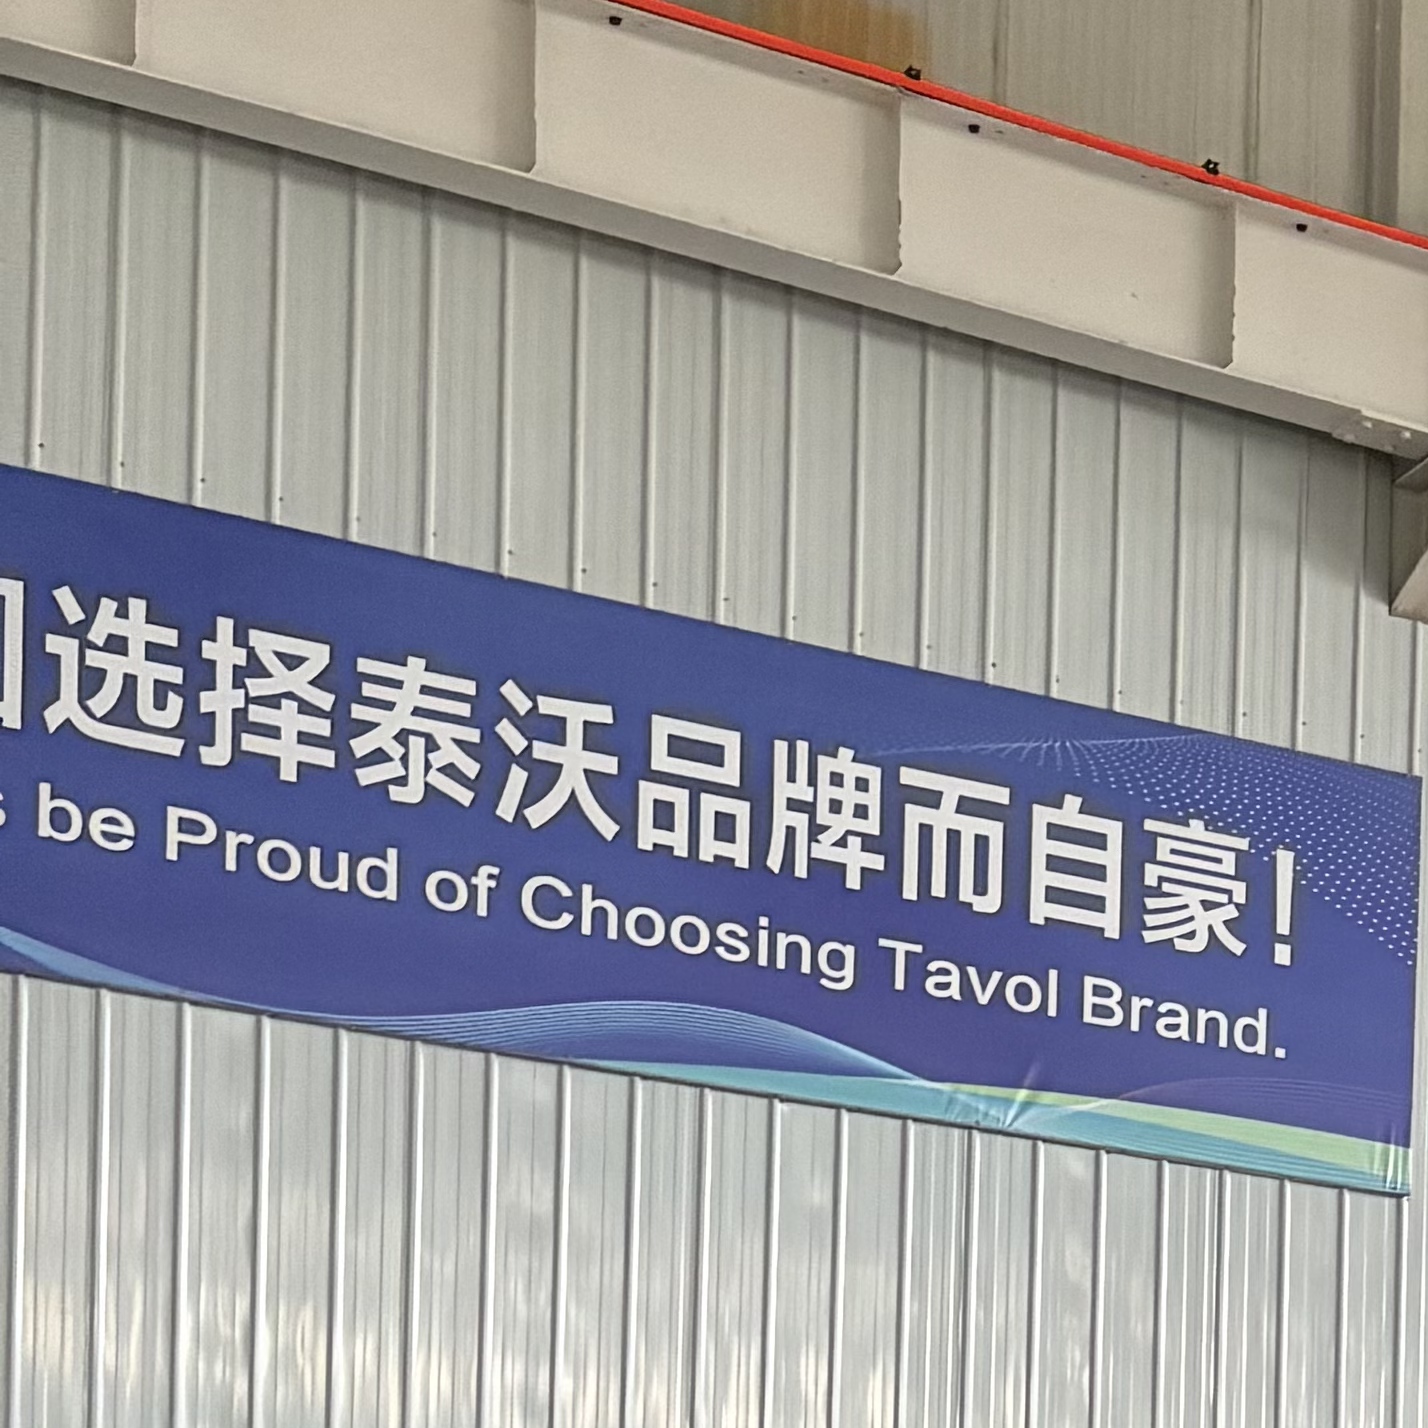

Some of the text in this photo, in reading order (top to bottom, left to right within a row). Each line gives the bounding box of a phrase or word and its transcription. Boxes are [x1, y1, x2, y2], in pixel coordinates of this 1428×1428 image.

[0, 577, 1295, 966] 选择泰沃品牌而自豪！
[38, 782, 135, 851] be
[166, 806, 398, 901] Proud
[425, 866, 500, 917] of
[521, 876, 855, 990] Choosing
[879, 938, 1058, 1018] Tavol
[1082, 976, 1287, 1058] Brand.
